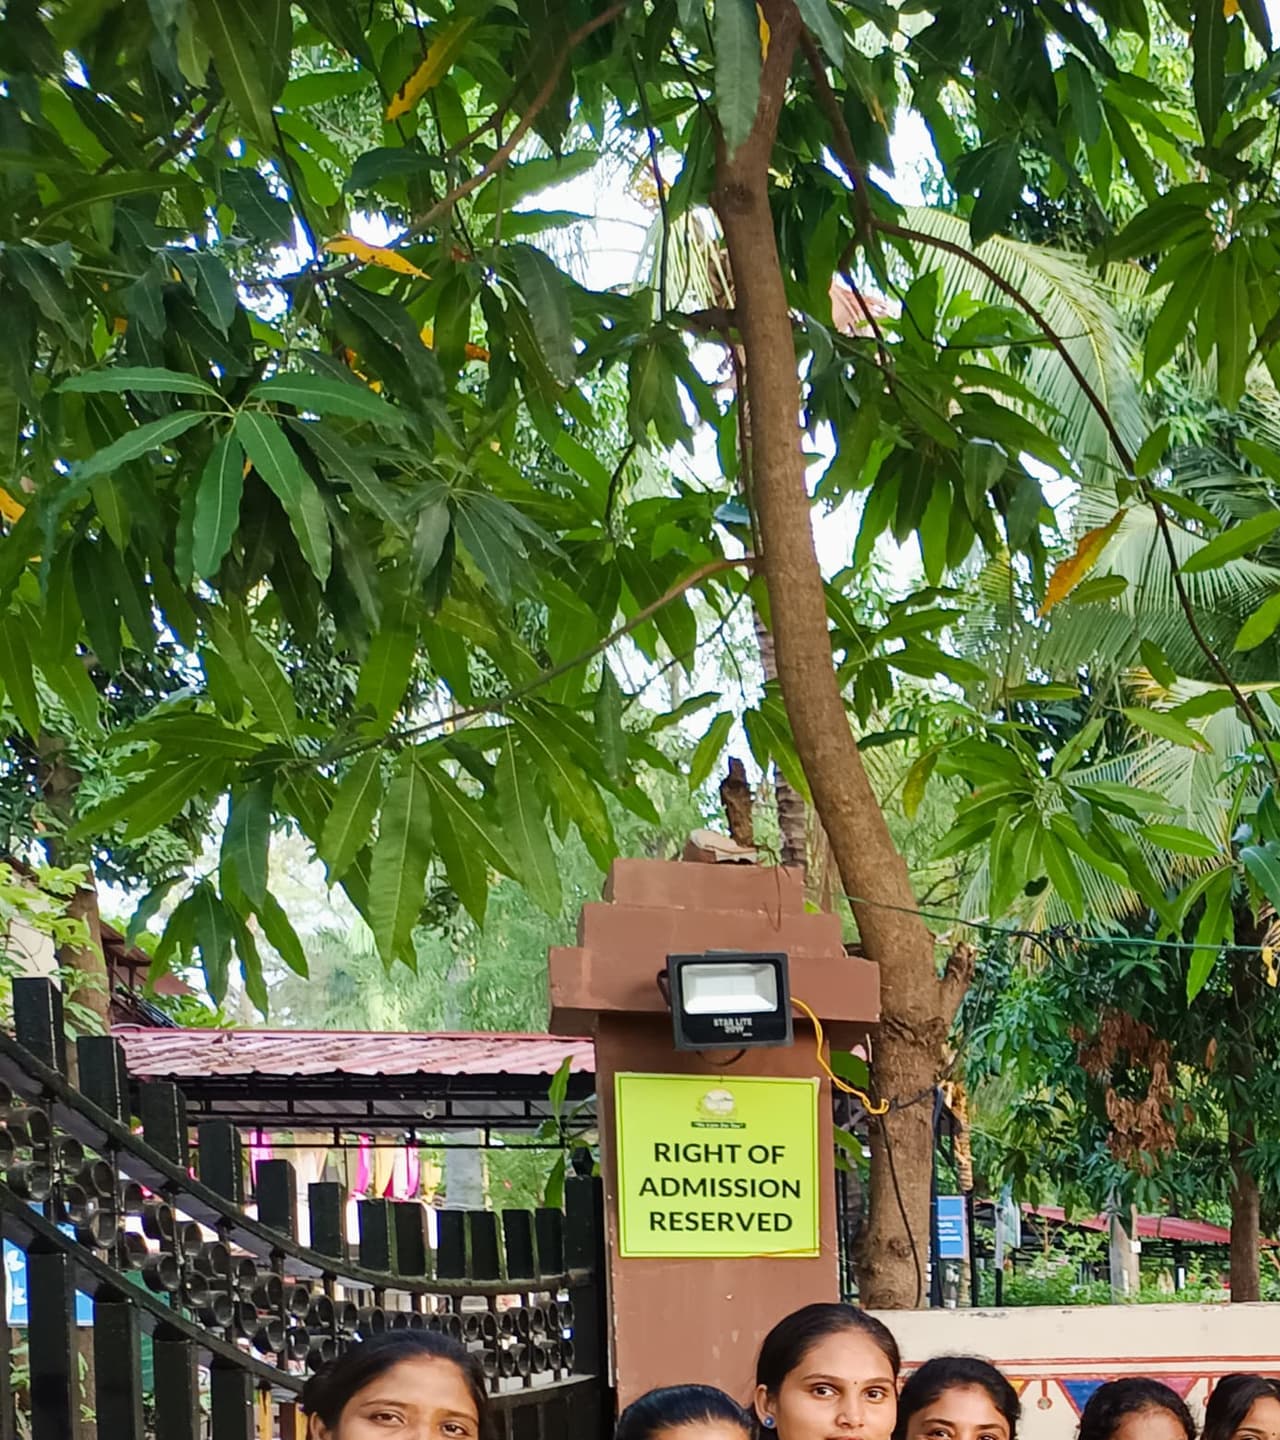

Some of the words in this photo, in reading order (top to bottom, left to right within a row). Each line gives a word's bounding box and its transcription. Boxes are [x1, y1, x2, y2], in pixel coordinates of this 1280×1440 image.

[653, 1142, 742, 1164] RIGHT
[747, 1144, 786, 1165] OF
[639, 1176, 801, 1199] ADMISSION
[649, 1211, 793, 1232] RESERVED
